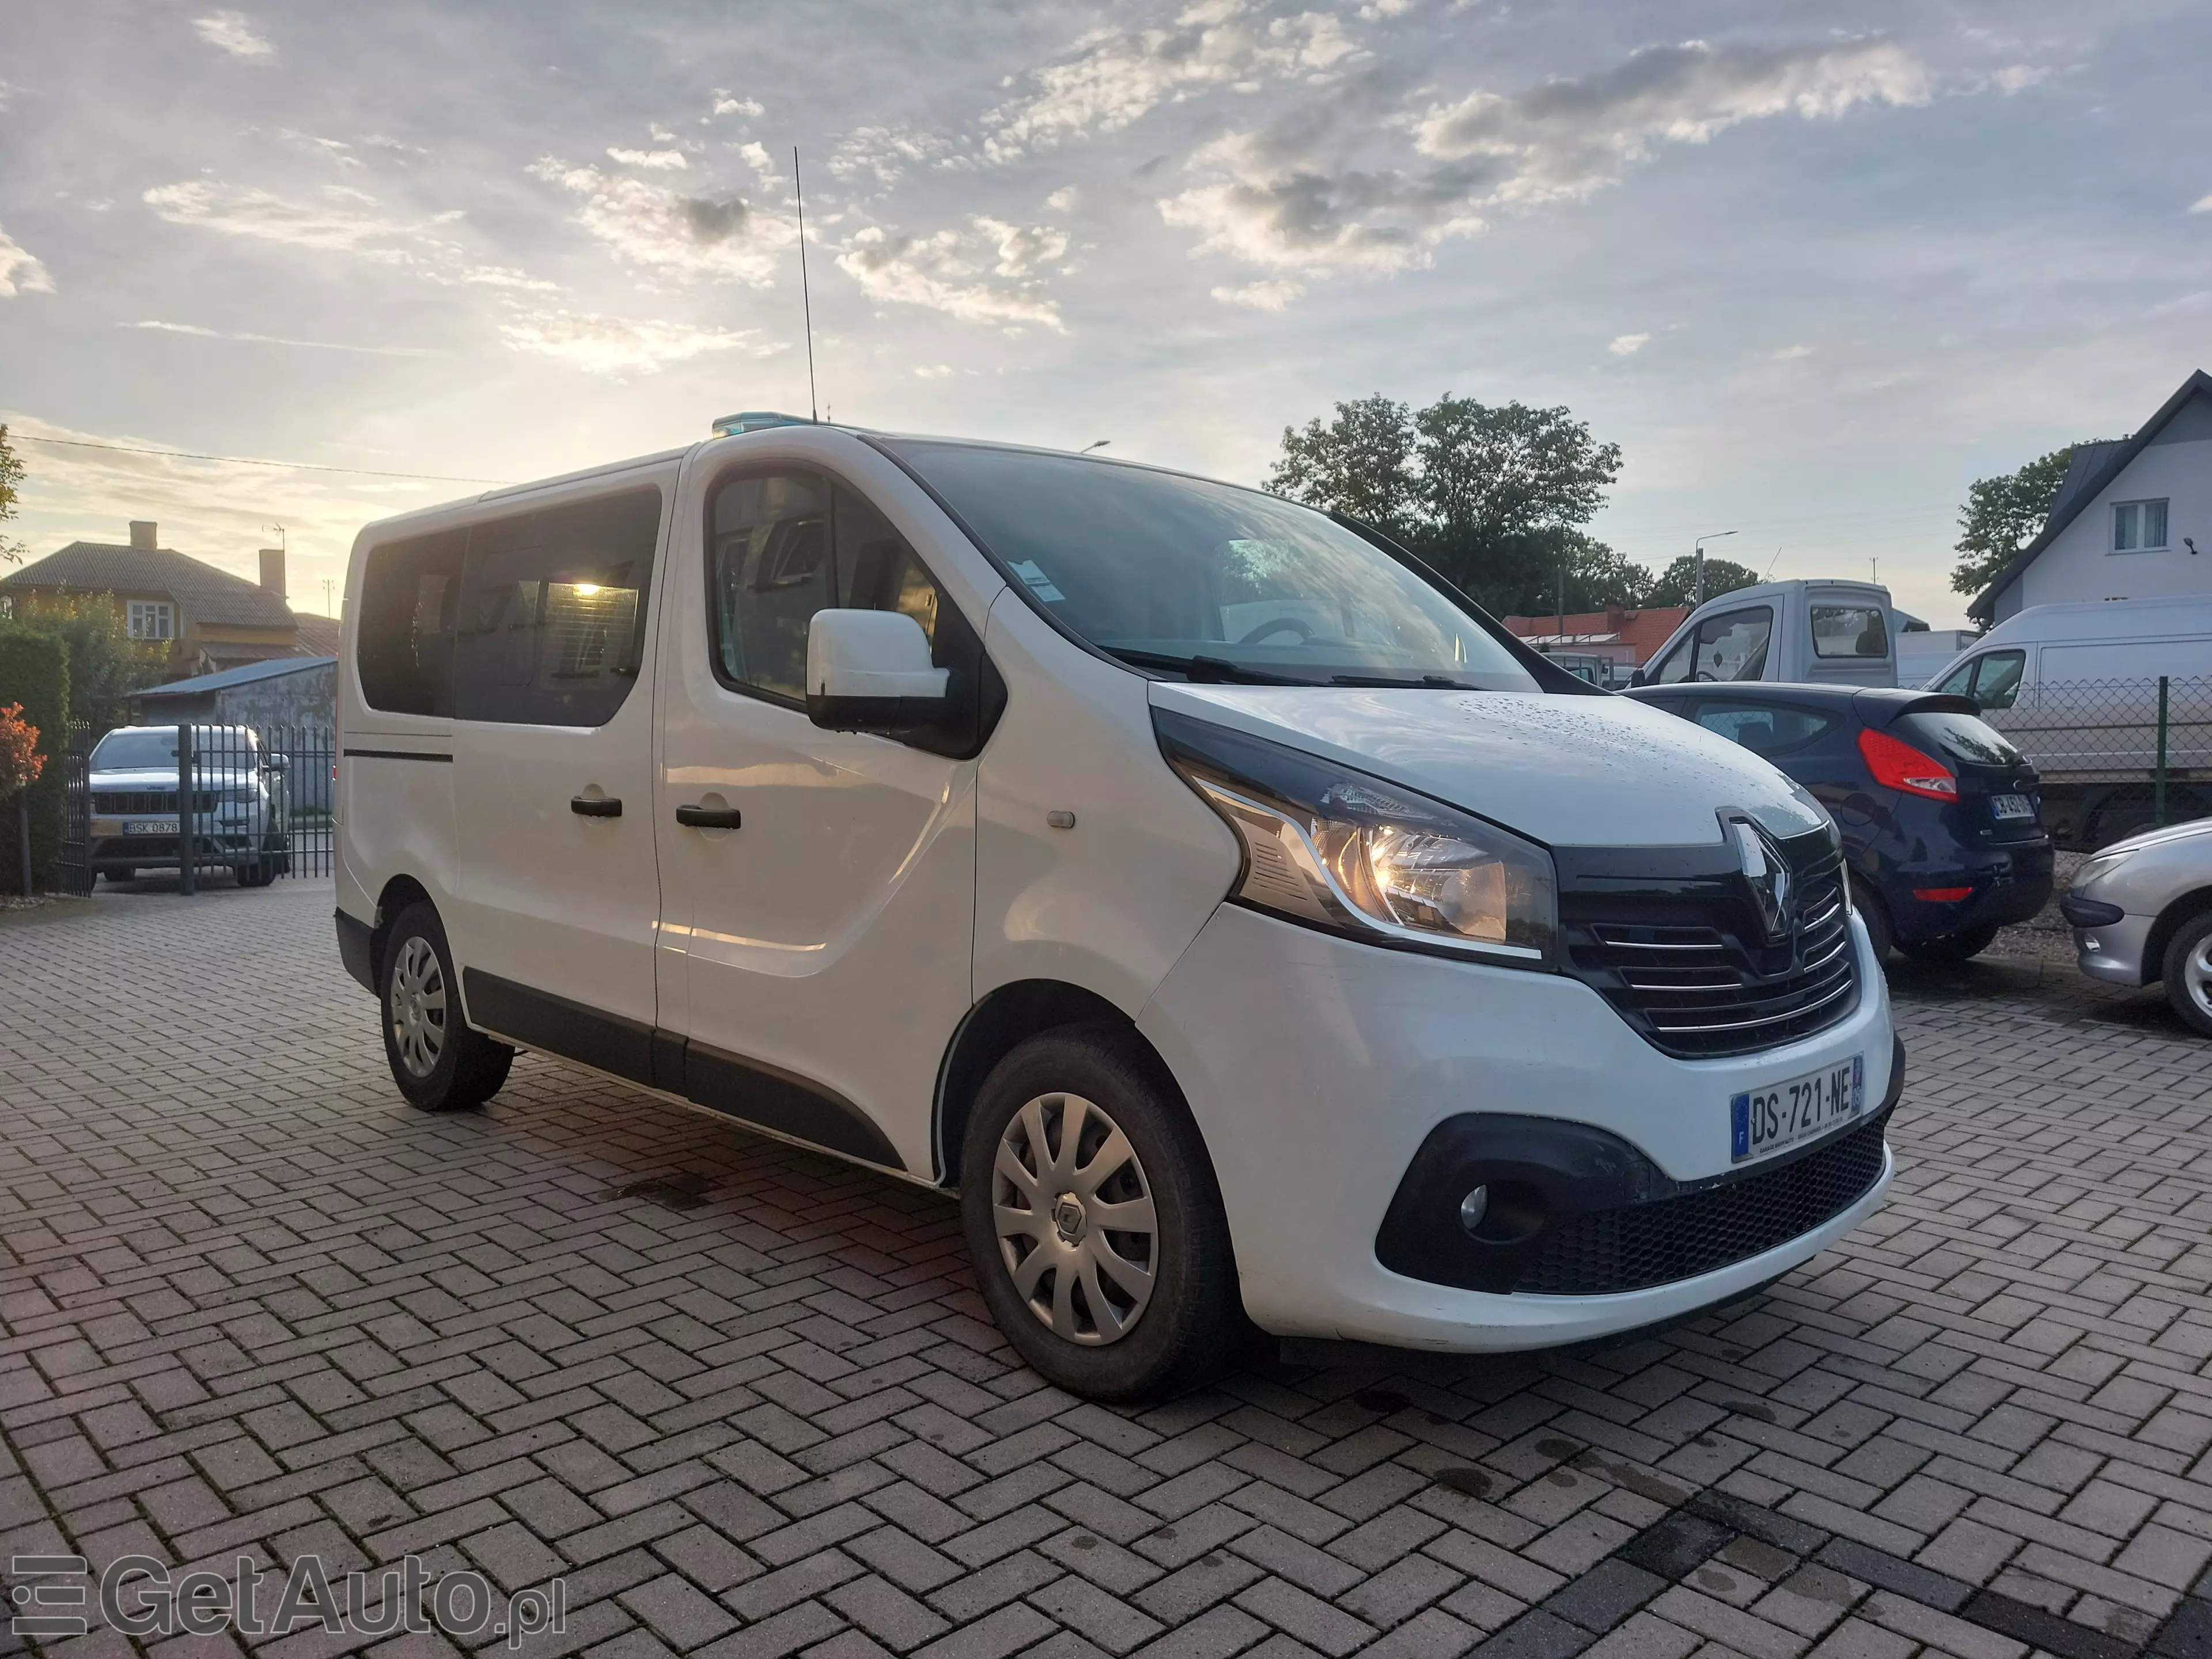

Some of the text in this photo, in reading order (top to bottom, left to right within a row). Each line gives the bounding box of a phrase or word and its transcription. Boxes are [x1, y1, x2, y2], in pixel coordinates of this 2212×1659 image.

[130, 823, 178, 832] BSK 0878
[1752, 1066, 1850, 1145] DS-721-NE
[1738, 1131, 1744, 1145] F
